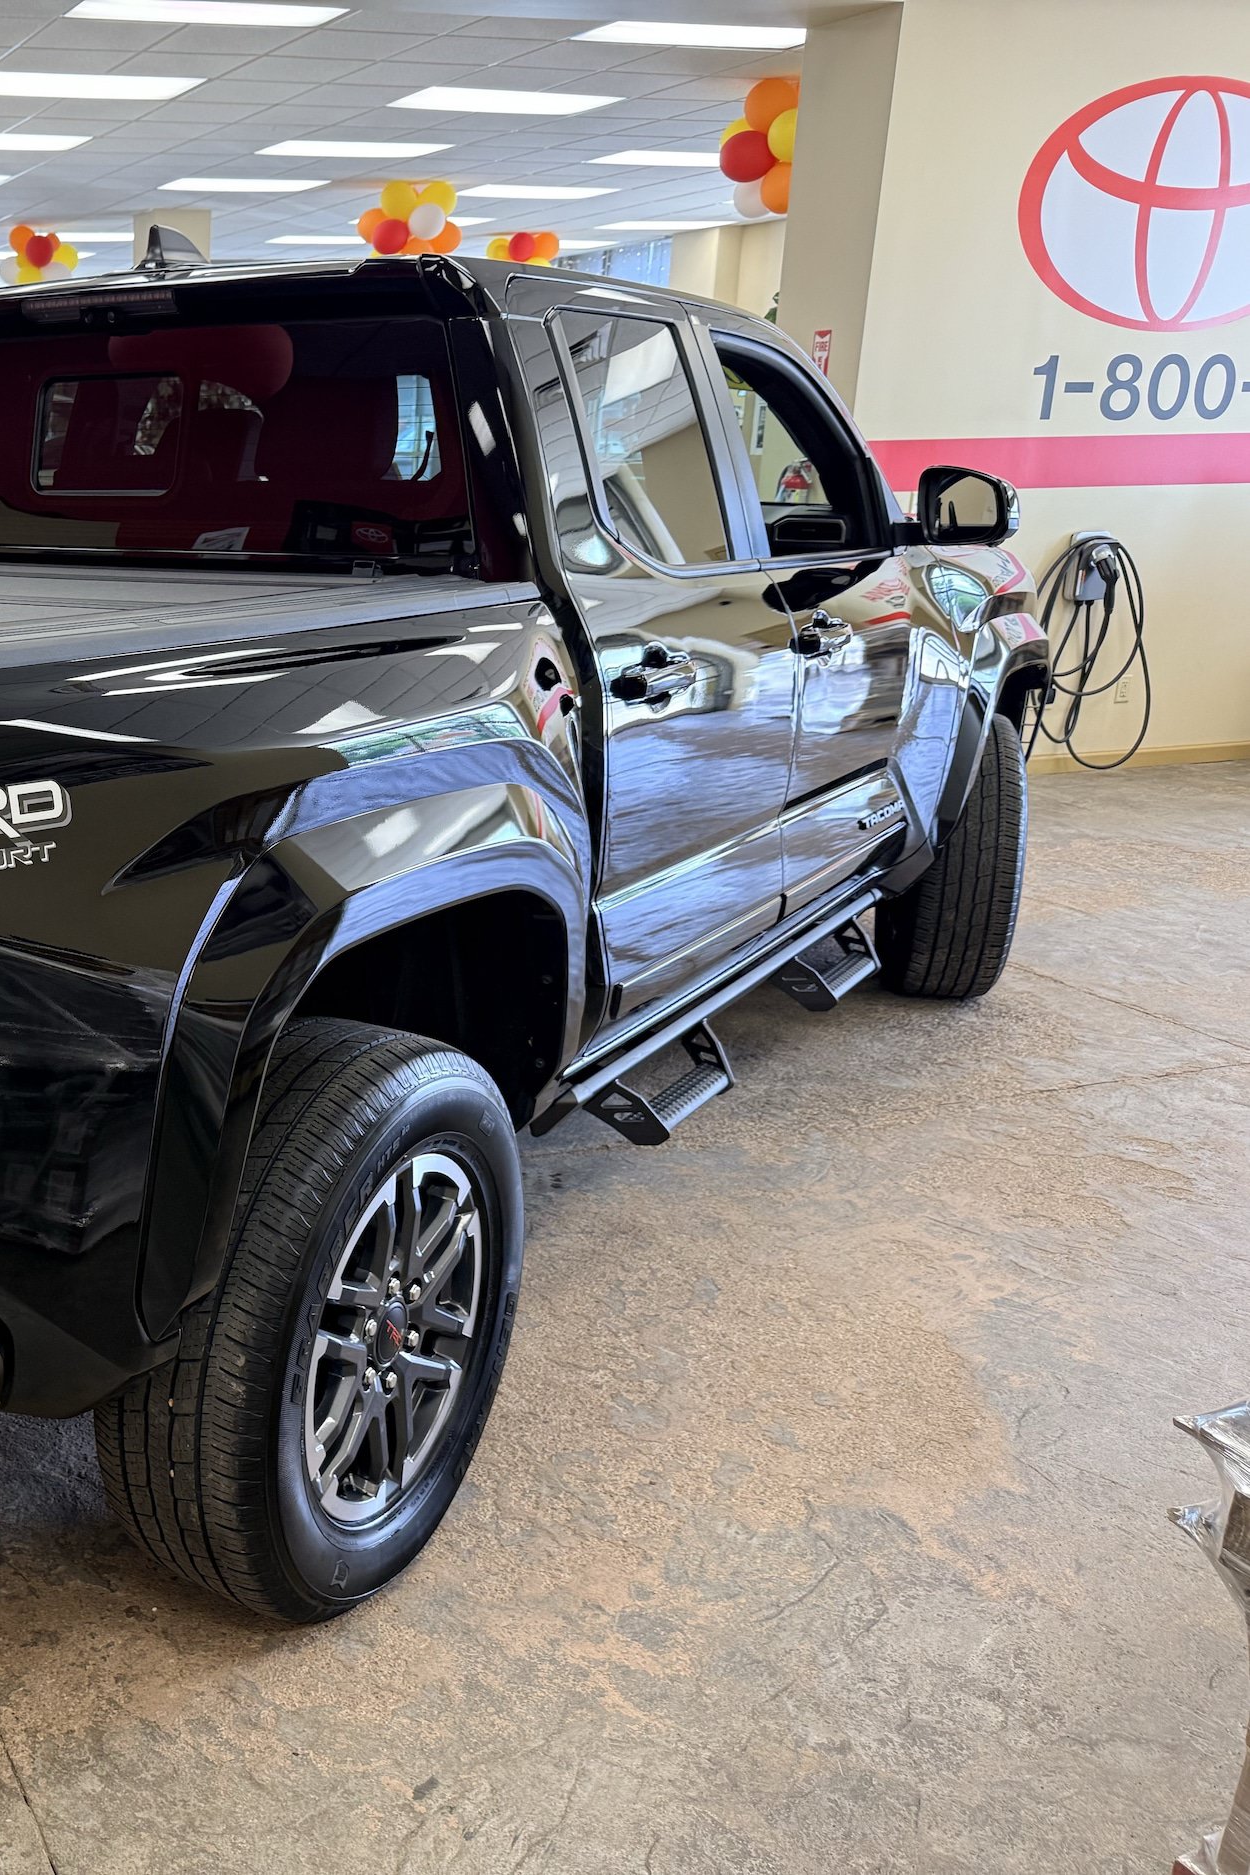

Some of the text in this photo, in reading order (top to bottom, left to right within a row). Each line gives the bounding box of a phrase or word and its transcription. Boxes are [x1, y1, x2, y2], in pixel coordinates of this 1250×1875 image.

[814, 341, 829, 352] FIRE
[1033, 353, 1250, 421] 1-800
[861, 799, 905, 829] TACOMA
